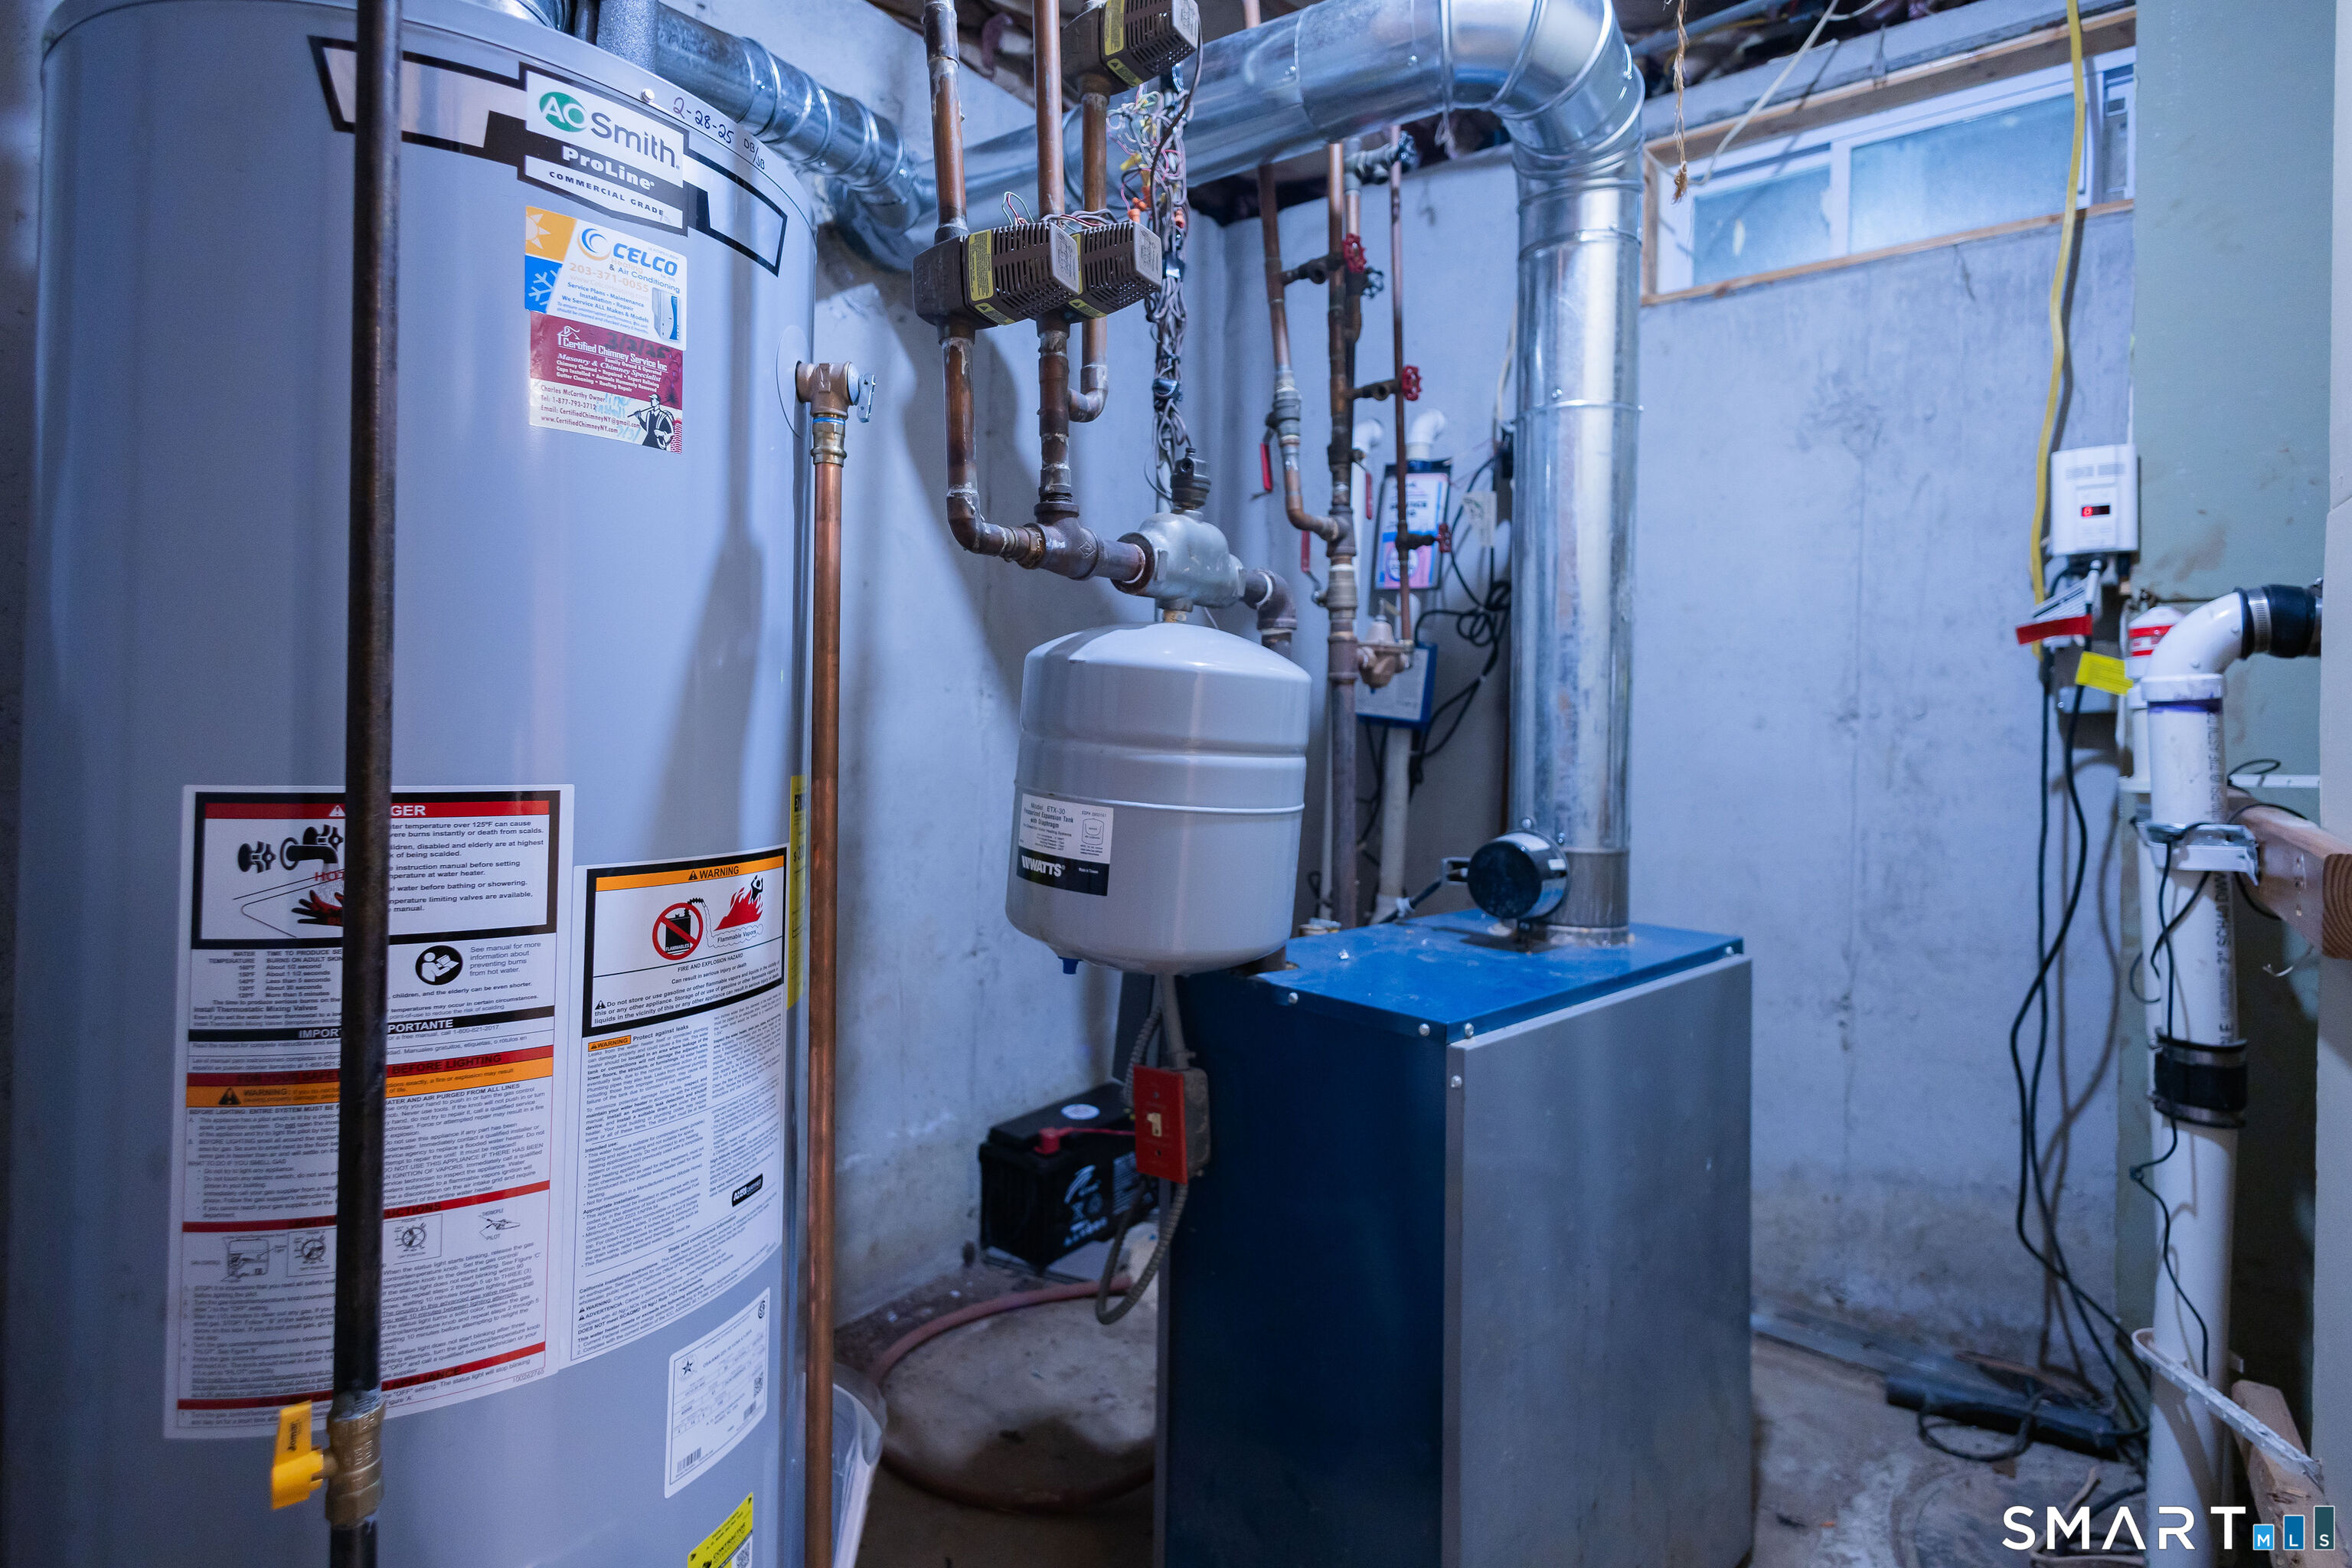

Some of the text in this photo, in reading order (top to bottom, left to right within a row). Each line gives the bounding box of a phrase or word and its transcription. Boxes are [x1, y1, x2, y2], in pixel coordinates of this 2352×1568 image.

[673, 96, 735, 144] 2-28-25
[590, 112, 676, 168] Smith
[562, 145, 652, 190] ProLine
[549, 171, 664, 216] COMMERCIAL GRADE
[612, 242, 678, 276] CELCO
[570, 262, 649, 292] 203-371-0055
[618, 267, 629, 276] Air
[631, 271, 680, 294] Conditioning
[568, 281, 645, 307] Service Plans Maintenance
[580, 292, 633, 311] Installation Repair
[562, 295, 650, 323] We Service Makes Models
[563, 336, 668, 372] Certified Chimney Service Inc
[557, 352, 662, 382] Masonry Chimney Specialist
[541, 384, 606, 403] Charles McCarthy Owner
[541, 404, 559, 413] Email:
[552, 397, 596, 410] 1-877-793-3712
[541, 415, 619, 433] www.CertifiedChimneyNY.com
[390, 805, 426, 816] GER
[1041, 812, 1061, 821] Expansion
[1047, 805, 1066, 815] ETX-30
[468, 841, 493, 849] elderly
[699, 865, 740, 880] WARNING
[1021, 854, 1062, 877] WATTS
[488, 880, 528, 889] showering.
[717, 929, 756, 943] Flammable Vapors
[486, 943, 512, 952] manual
[666, 942, 691, 952] FLAMMABLES
[469, 960, 507, 969] preventing
[470, 952, 508, 961] information
[701, 957, 727, 969] EXPLOSION
[727, 952, 743, 962] HAZARD
[663, 988, 685, 998] gasoline
[706, 978, 727, 988] flammable
[594, 1016, 616, 1024] liquids
[635, 1008, 655, 1017] vicinity
[704, 991, 725, 1001] appliance
[645, 998, 674, 1008] appliance.
[675, 994, 694, 1004] Storage
[387, 1019, 453, 1034] PORTANTE
[597, 1037, 628, 1048] WARNING
[632, 1033, 653, 1041] Protect
[655, 1028, 675, 1037] against
[391, 1054, 502, 1075] BEFORE LIGHTING
[436, 1091, 465, 1100] PURGED
[466, 1088, 486, 1096] FROM
